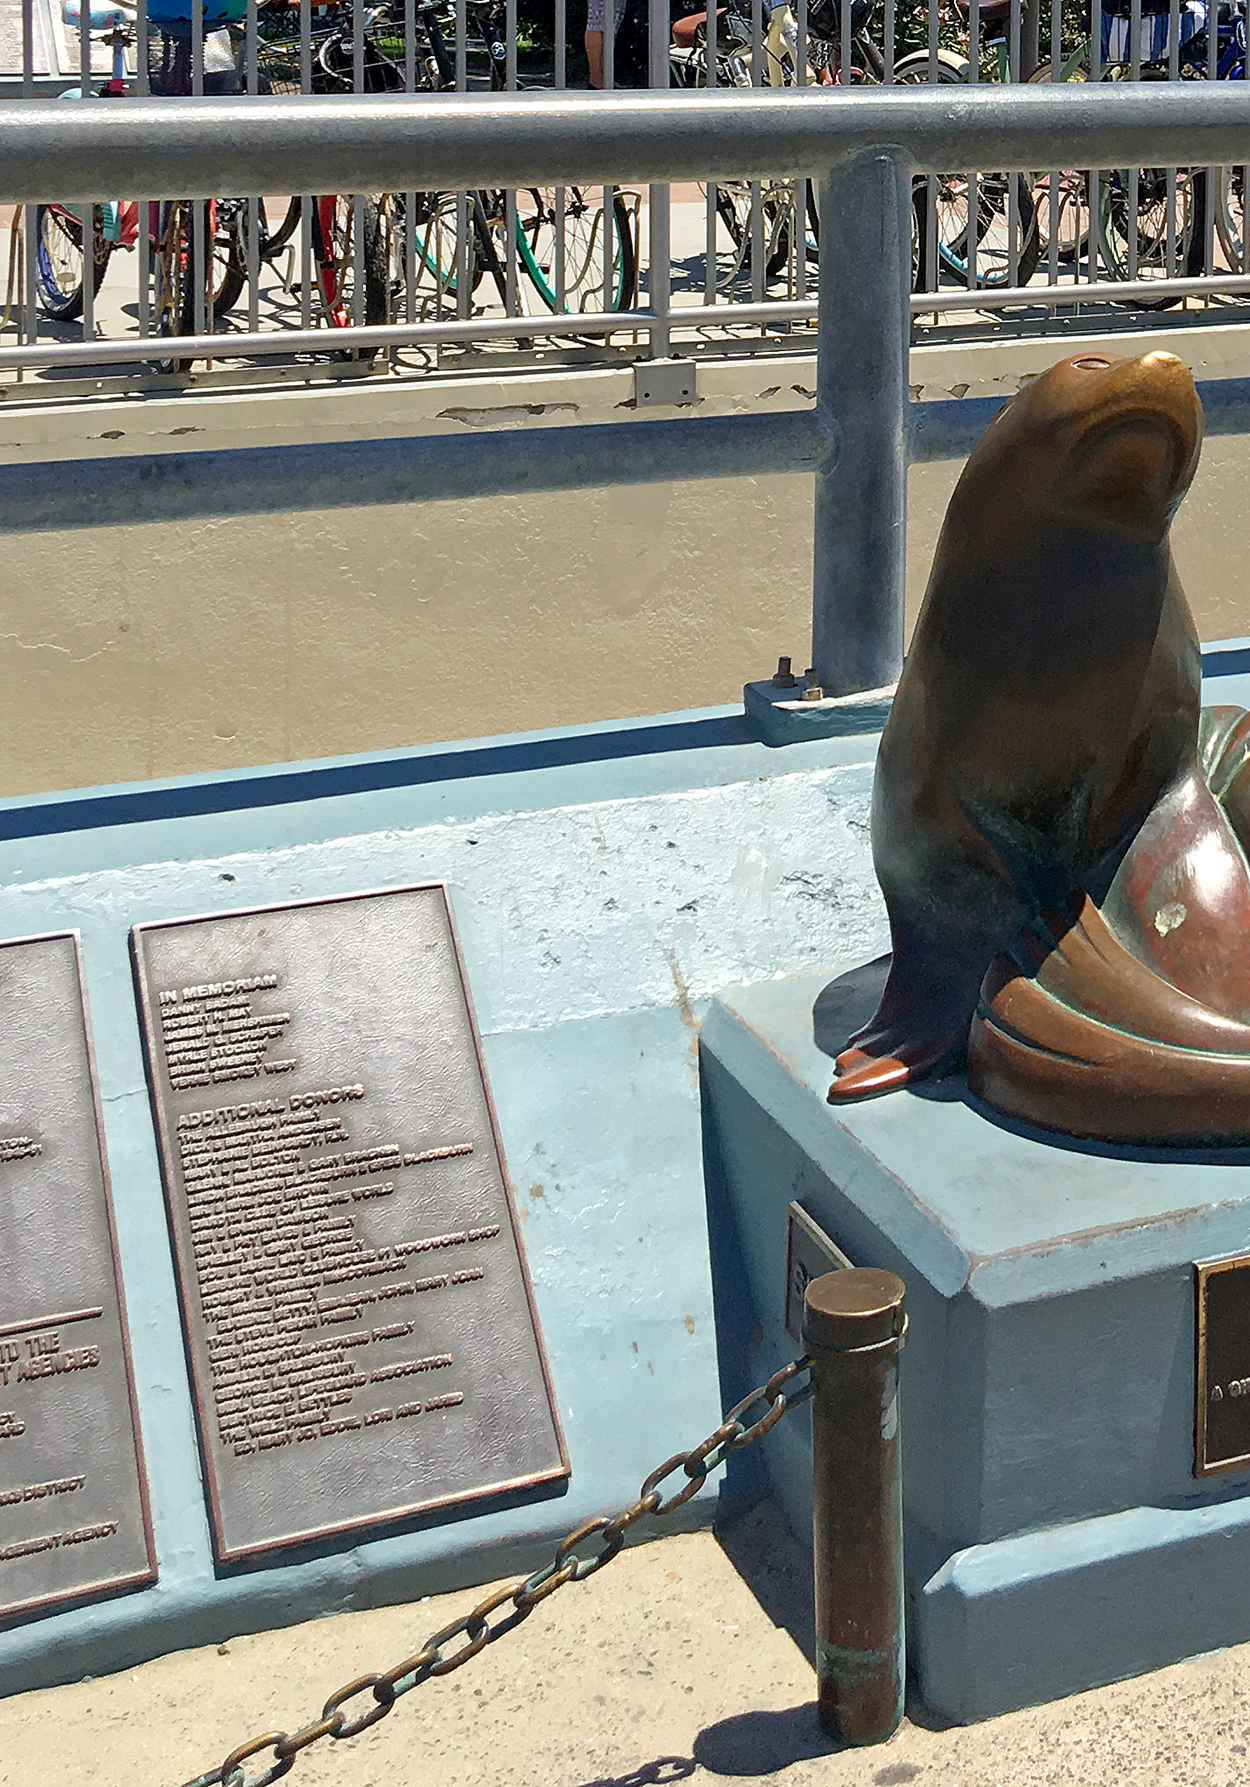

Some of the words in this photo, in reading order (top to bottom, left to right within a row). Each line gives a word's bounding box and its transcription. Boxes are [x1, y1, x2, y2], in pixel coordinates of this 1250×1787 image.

[159, 990, 177, 1005] IN
[182, 974, 277, 1001] MEMORIAM
[161, 1004, 202, 1019] DANNY
[163, 1014, 210, 1030] ROBERT
[228, 1007, 253, 1019] MAY
[164, 1027, 203, 1042] JAMES
[166, 1038, 210, 1054] JERALD
[167, 1050, 207, 1065] MYRLE
[169, 1061, 207, 1077] BRIAN
[209, 1052, 264, 1070] SWEENEY
[264, 1059, 297, 1074] WEST
[175, 1098, 284, 1130] ADDITIONAL
[288, 1084, 363, 1110] DONORS
[178, 1131, 202, 1144] THE
[279, 1110, 320, 1126] FAMILY
[181, 1142, 208, 1156] DICK
[351, 1182, 393, 1199] WORLD
[254, 1266, 298, 1286] WORLD
[394, 1232, 465, 1256] WOODWORK
[467, 1225, 500, 1241] SHOP
[25, 1331, 61, 1358] THE
[205, 1334, 232, 1349] THE
[210, 1360, 237, 1377] THE
[371, 1321, 416, 1341] FAMILY
[17, 1345, 99, 1383] AGENCIES
[251, 1389, 294, 1410] BEACH
[297, 1373, 367, 1399] LIFEGUARD
[369, 1353, 453, 1383] ASSOCIATION
[219, 1428, 246, 1445] THE
[23, 1474, 86, 1503] DISTRICT
[62, 1520, 119, 1547] AGENCY
